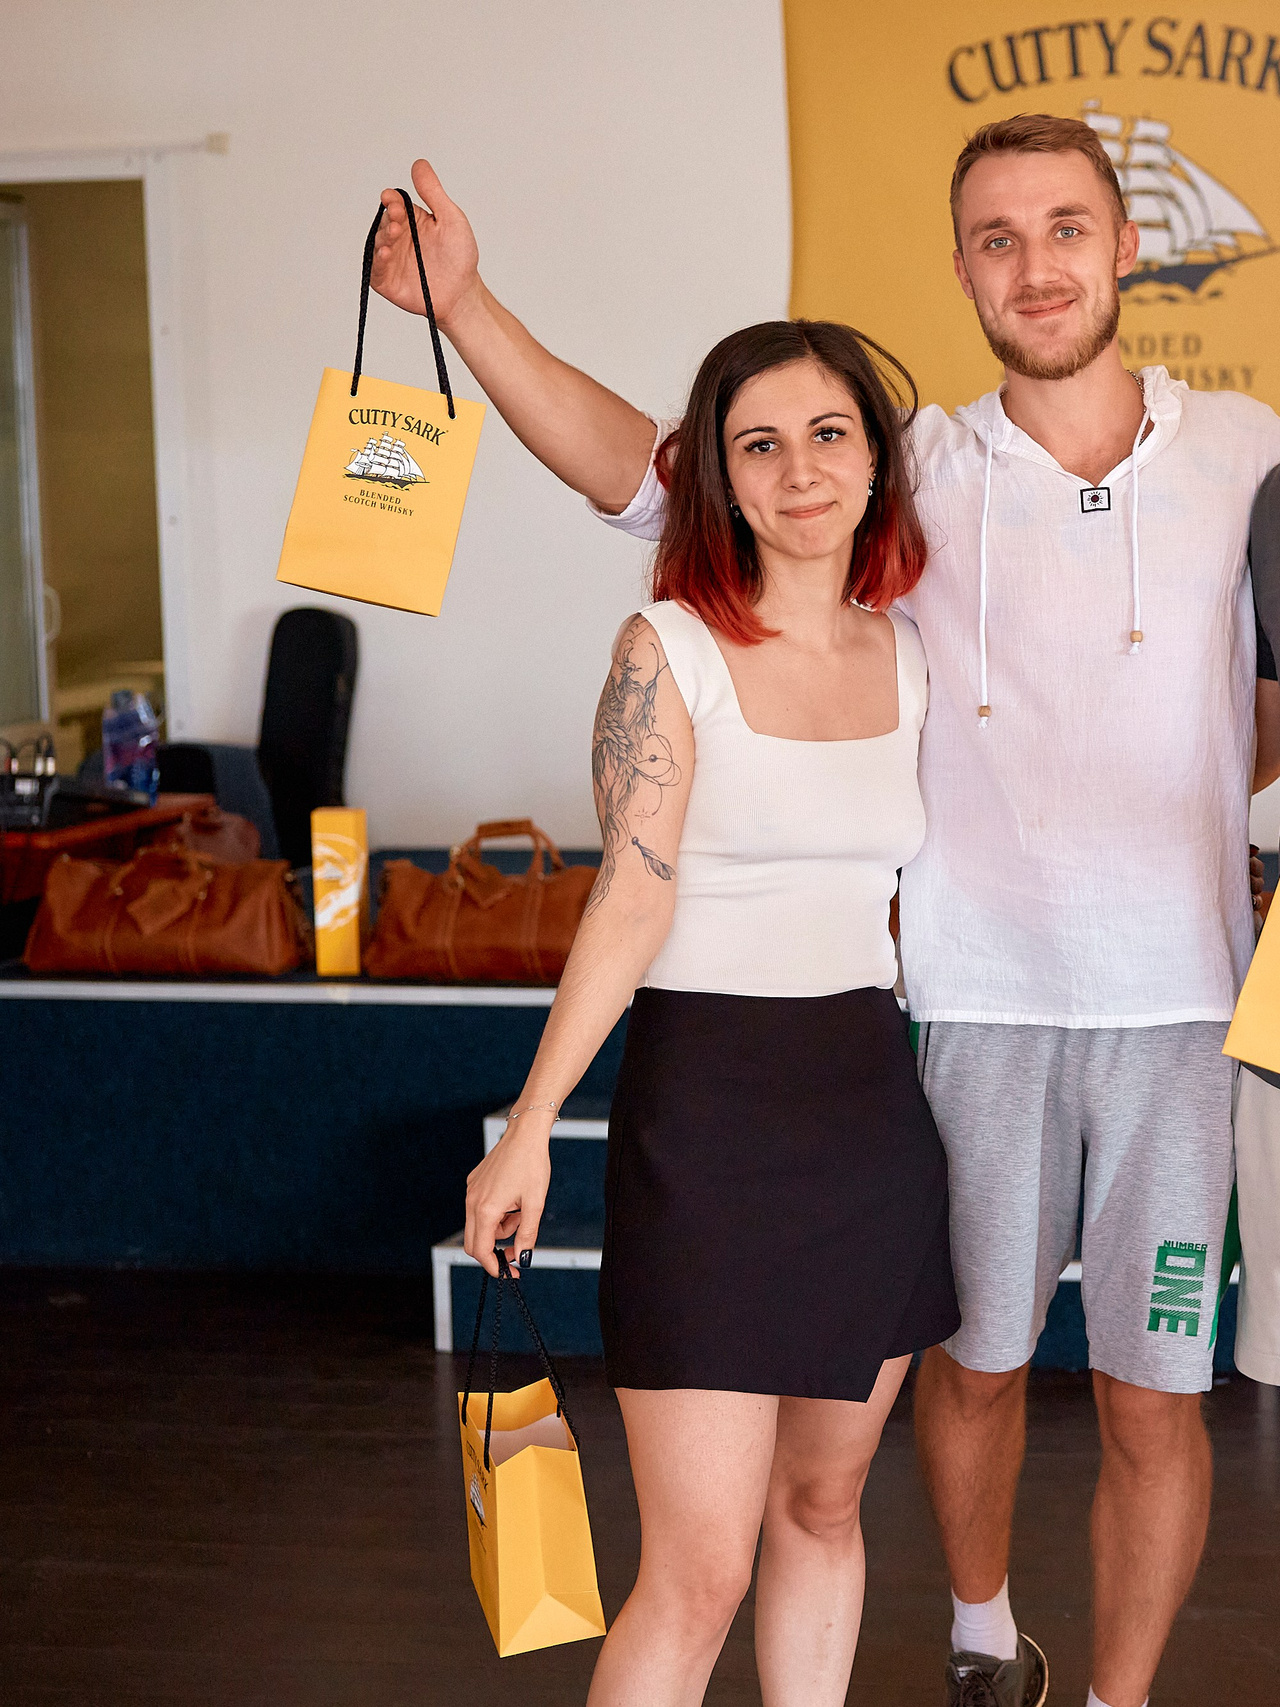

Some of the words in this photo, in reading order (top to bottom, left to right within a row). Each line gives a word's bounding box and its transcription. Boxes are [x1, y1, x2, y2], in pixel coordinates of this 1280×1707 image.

[945, 18, 1132, 102] CUTTY
[1118, 332, 1202, 359] NDED
[348, 409, 402, 428] CUTTY
[401, 415, 446, 446] SARK
[343, 494, 377, 508] SCOTCH
[380, 502, 414, 517] WHISKY
[359, 489, 402, 505] BLENDED
[1163, 1240, 1208, 1252] NUMBER
[1147, 1246, 1207, 1337] ONE
